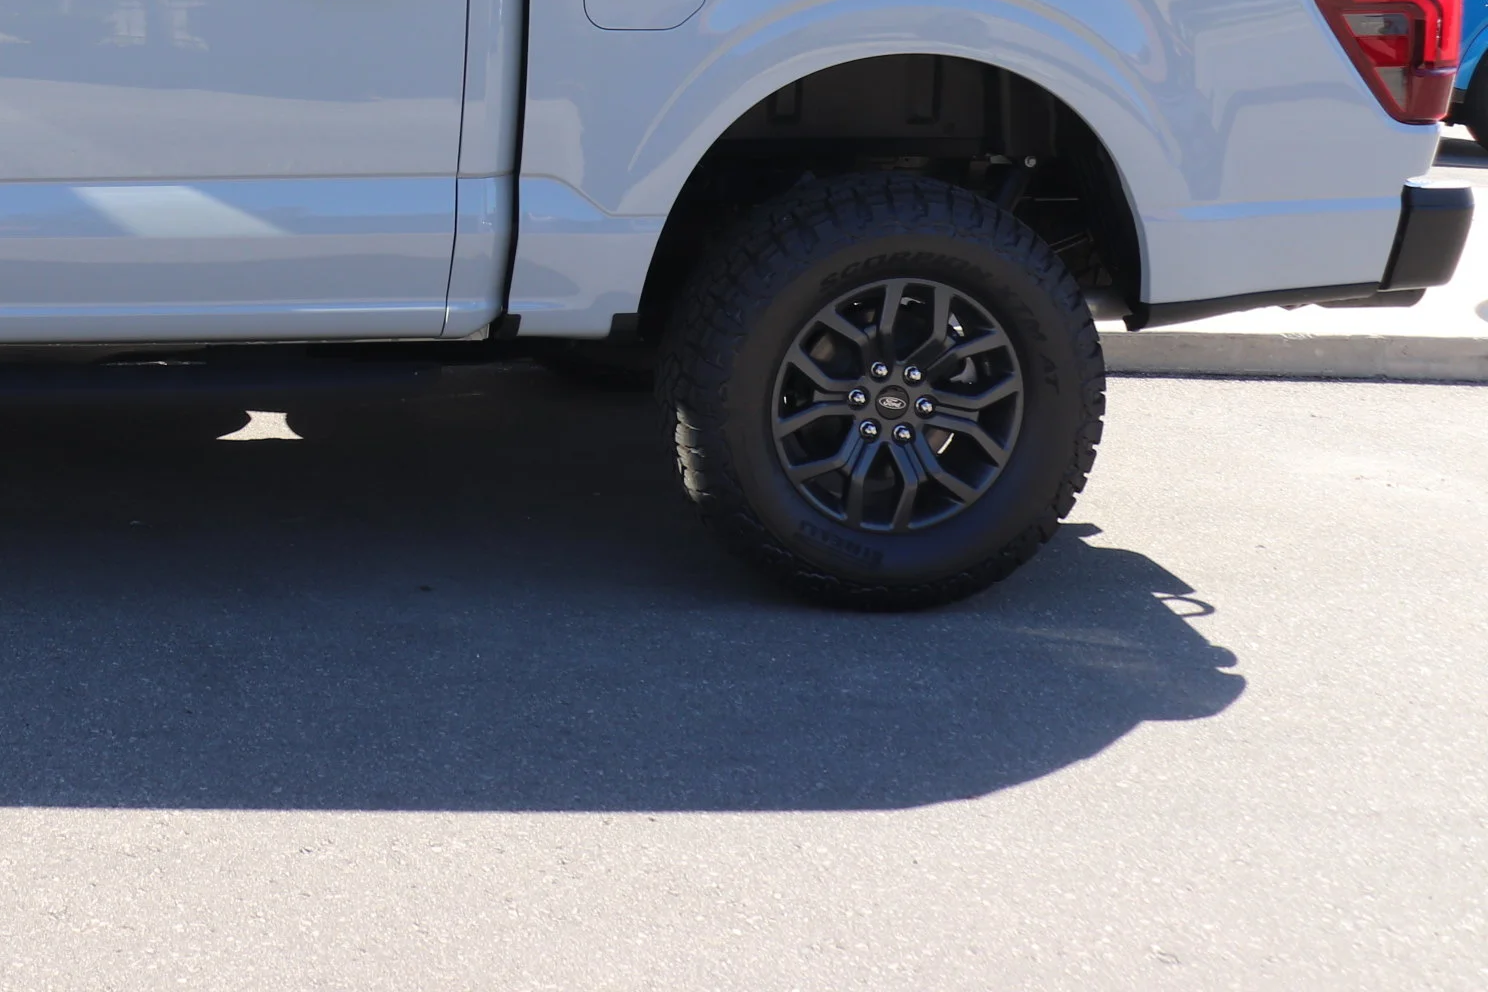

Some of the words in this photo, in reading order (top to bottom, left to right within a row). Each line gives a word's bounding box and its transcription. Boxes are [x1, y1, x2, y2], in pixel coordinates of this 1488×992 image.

[820, 250, 994, 292] SCORPION
[1041, 352, 1060, 394] AT
[882, 398, 903, 408] Ford
